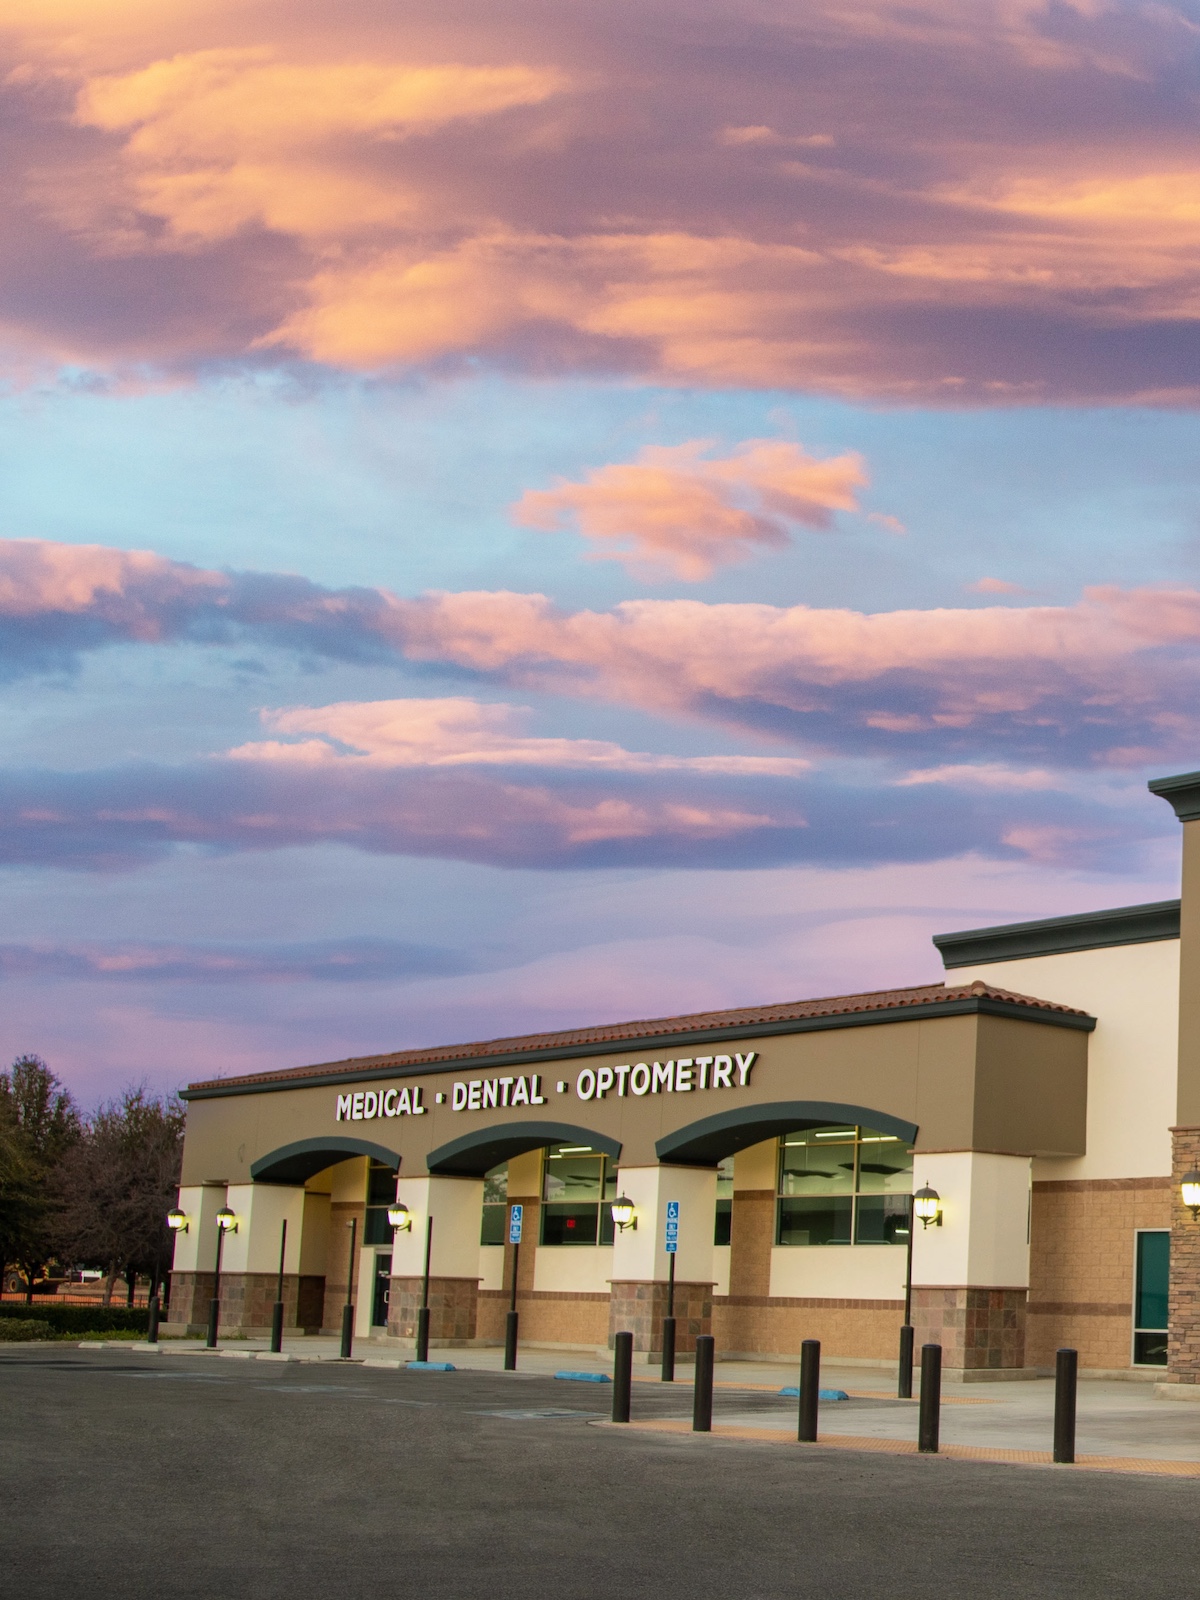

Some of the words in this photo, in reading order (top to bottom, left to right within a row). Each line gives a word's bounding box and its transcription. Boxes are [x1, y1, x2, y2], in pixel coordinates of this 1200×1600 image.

[336, 1086, 425, 1121] MEDICAL
[452, 1074, 545, 1111] DENTAL
[576, 1051, 757, 1101] OPTOMETRY
